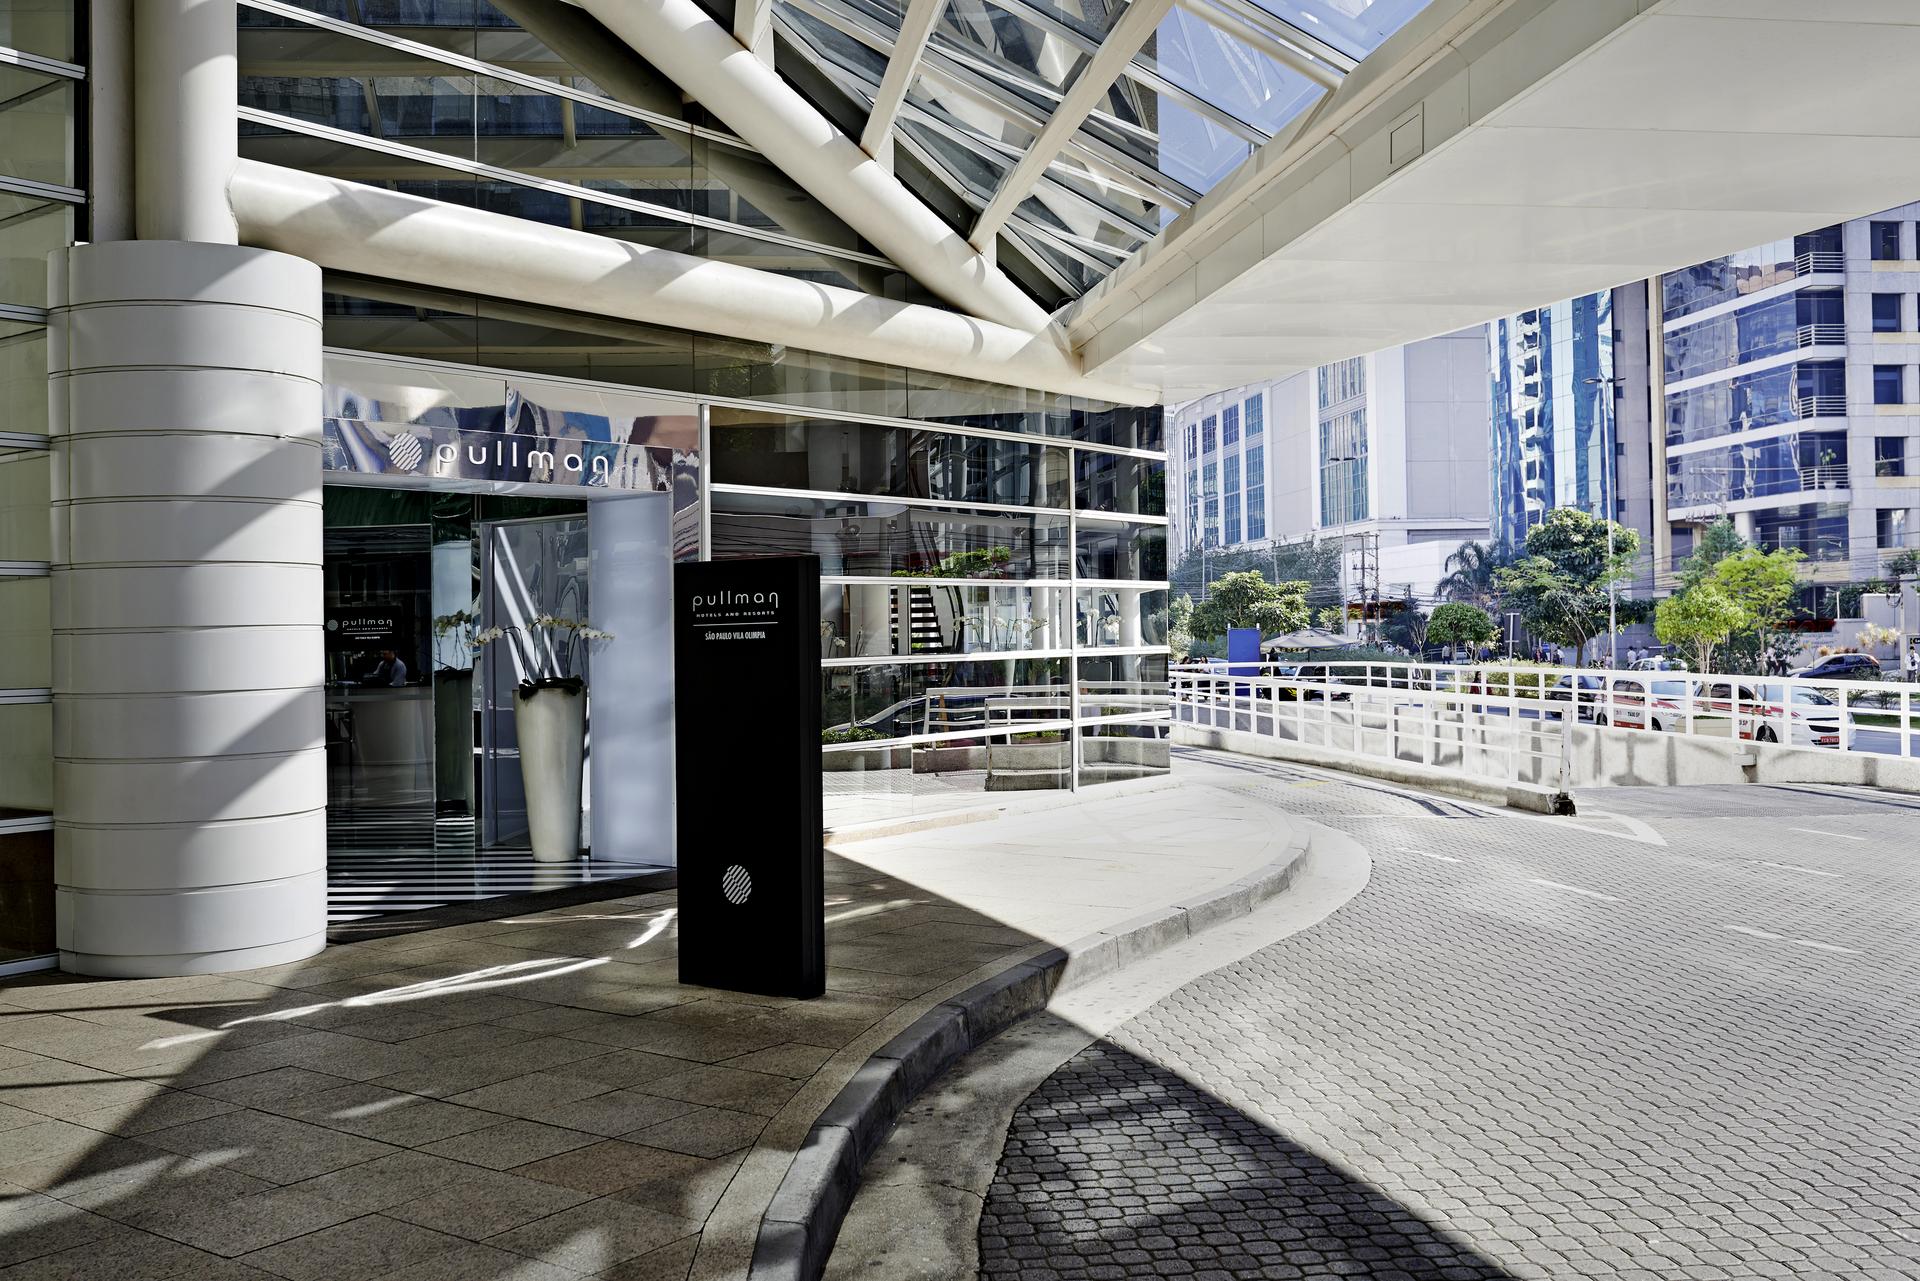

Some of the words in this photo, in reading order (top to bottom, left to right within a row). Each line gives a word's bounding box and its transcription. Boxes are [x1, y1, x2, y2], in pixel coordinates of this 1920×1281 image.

[435, 440, 610, 485] pullman
[692, 590, 779, 612] pullman
[342, 618, 393, 628] pullman
[705, 631, 716, 640] SÃO
[716, 632, 732, 640] PAULO
[733, 632, 745, 640] VILA
